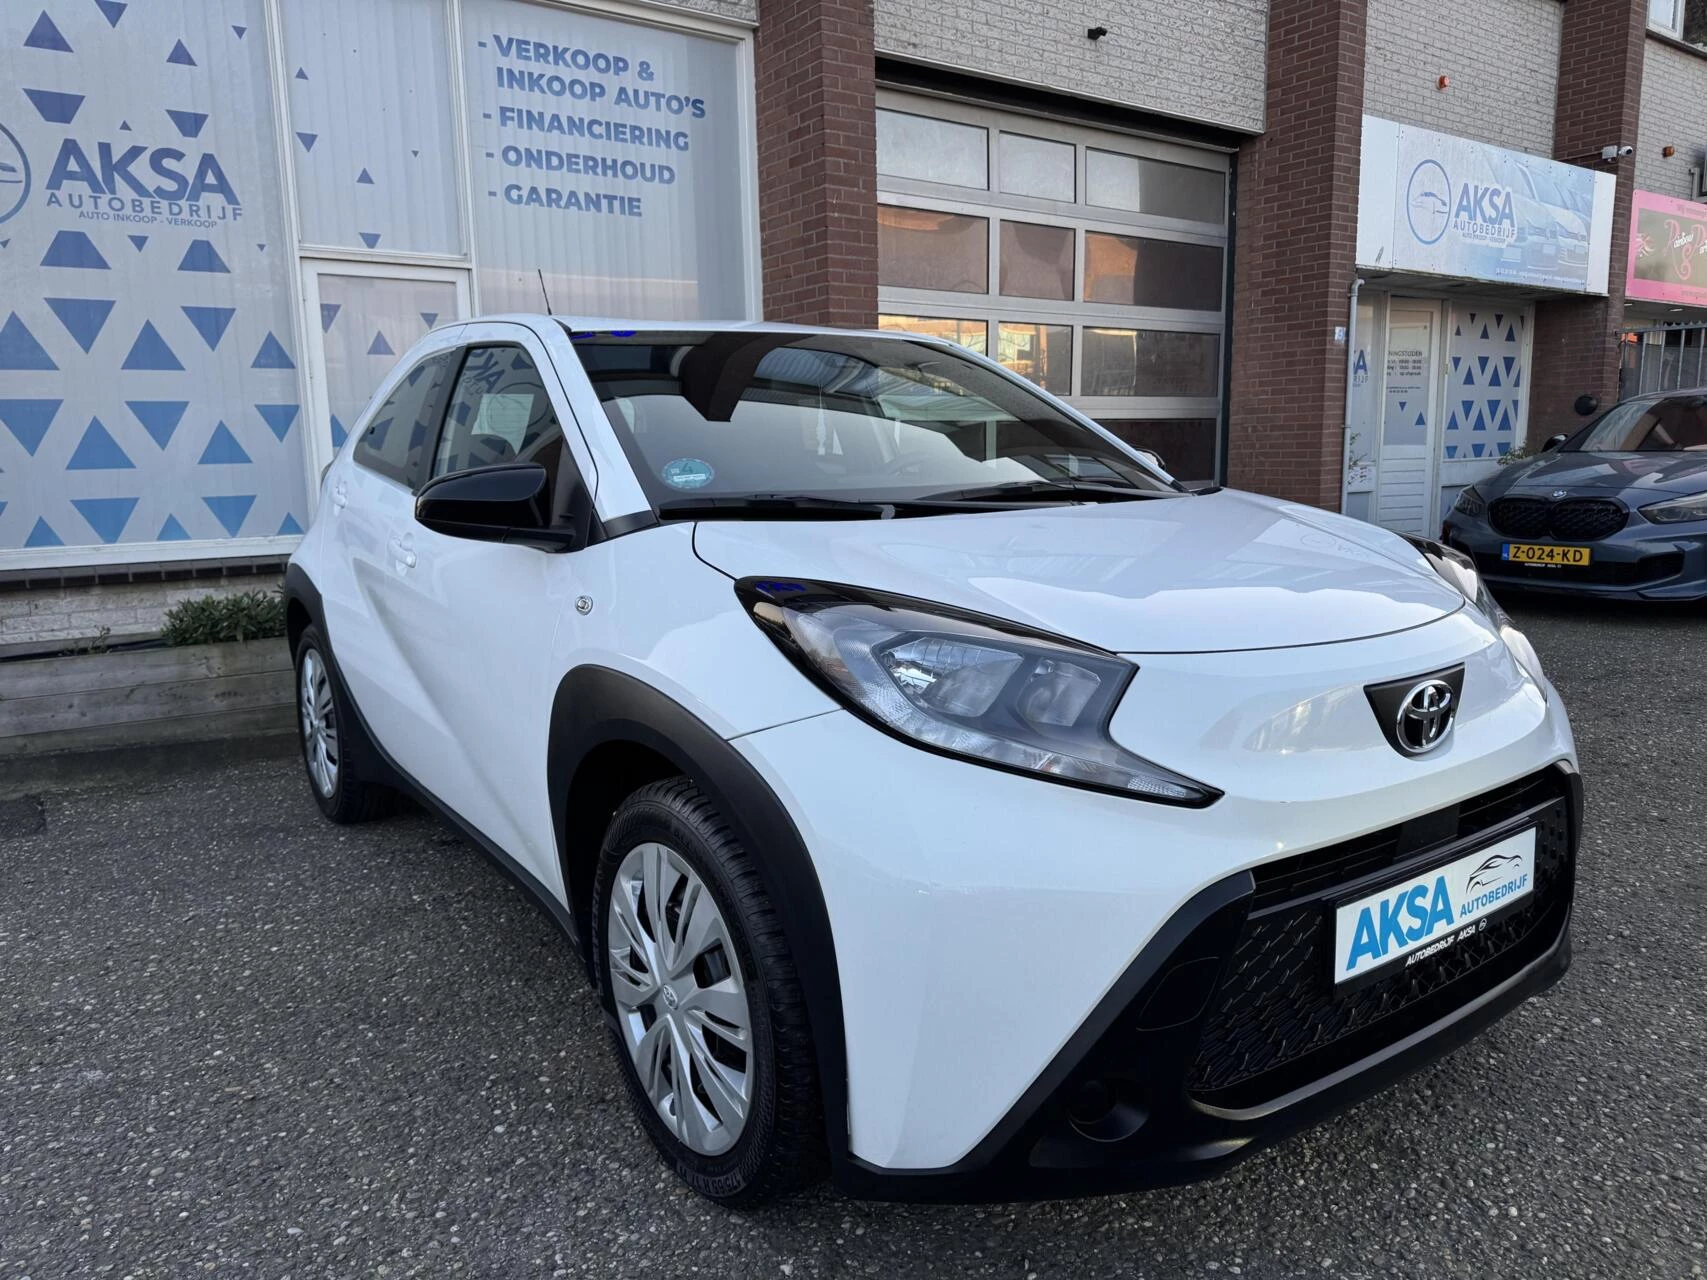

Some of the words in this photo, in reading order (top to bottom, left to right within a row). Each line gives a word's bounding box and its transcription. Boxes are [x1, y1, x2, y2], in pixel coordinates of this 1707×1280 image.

[492, 34, 629, 76] VERKOOP
[637, 60, 654, 82] &
[496, 66, 606, 102] INKOOP
[614, 86, 706, 119] AUTO'S
[499, 106, 689, 151] FINANCIERING
[45, 138, 241, 206] AKSA
[501, 145, 676, 185] ONDERHOUD
[46, 191, 243, 221] AUTOBEDRIJF
[78, 210, 110, 221] AUTO
[113, 213, 158, 224] INKOOP
[166, 217, 217, 229] VERKOOP
[504, 183, 642, 217] GARANTIE
[1454, 182, 1515, 228] AKSA
[1453, 219, 1516, 239] AUTOBEDRIJF
[1512, 546, 1583, 562] Z-024-KD
[1459, 873, 1528, 919] AUTOBEDRIJF
[1346, 875, 1454, 971] AKSA
[1405, 935, 1455, 968] AUTOBEDRIJF
[1456, 924, 1476, 942] AKSA
